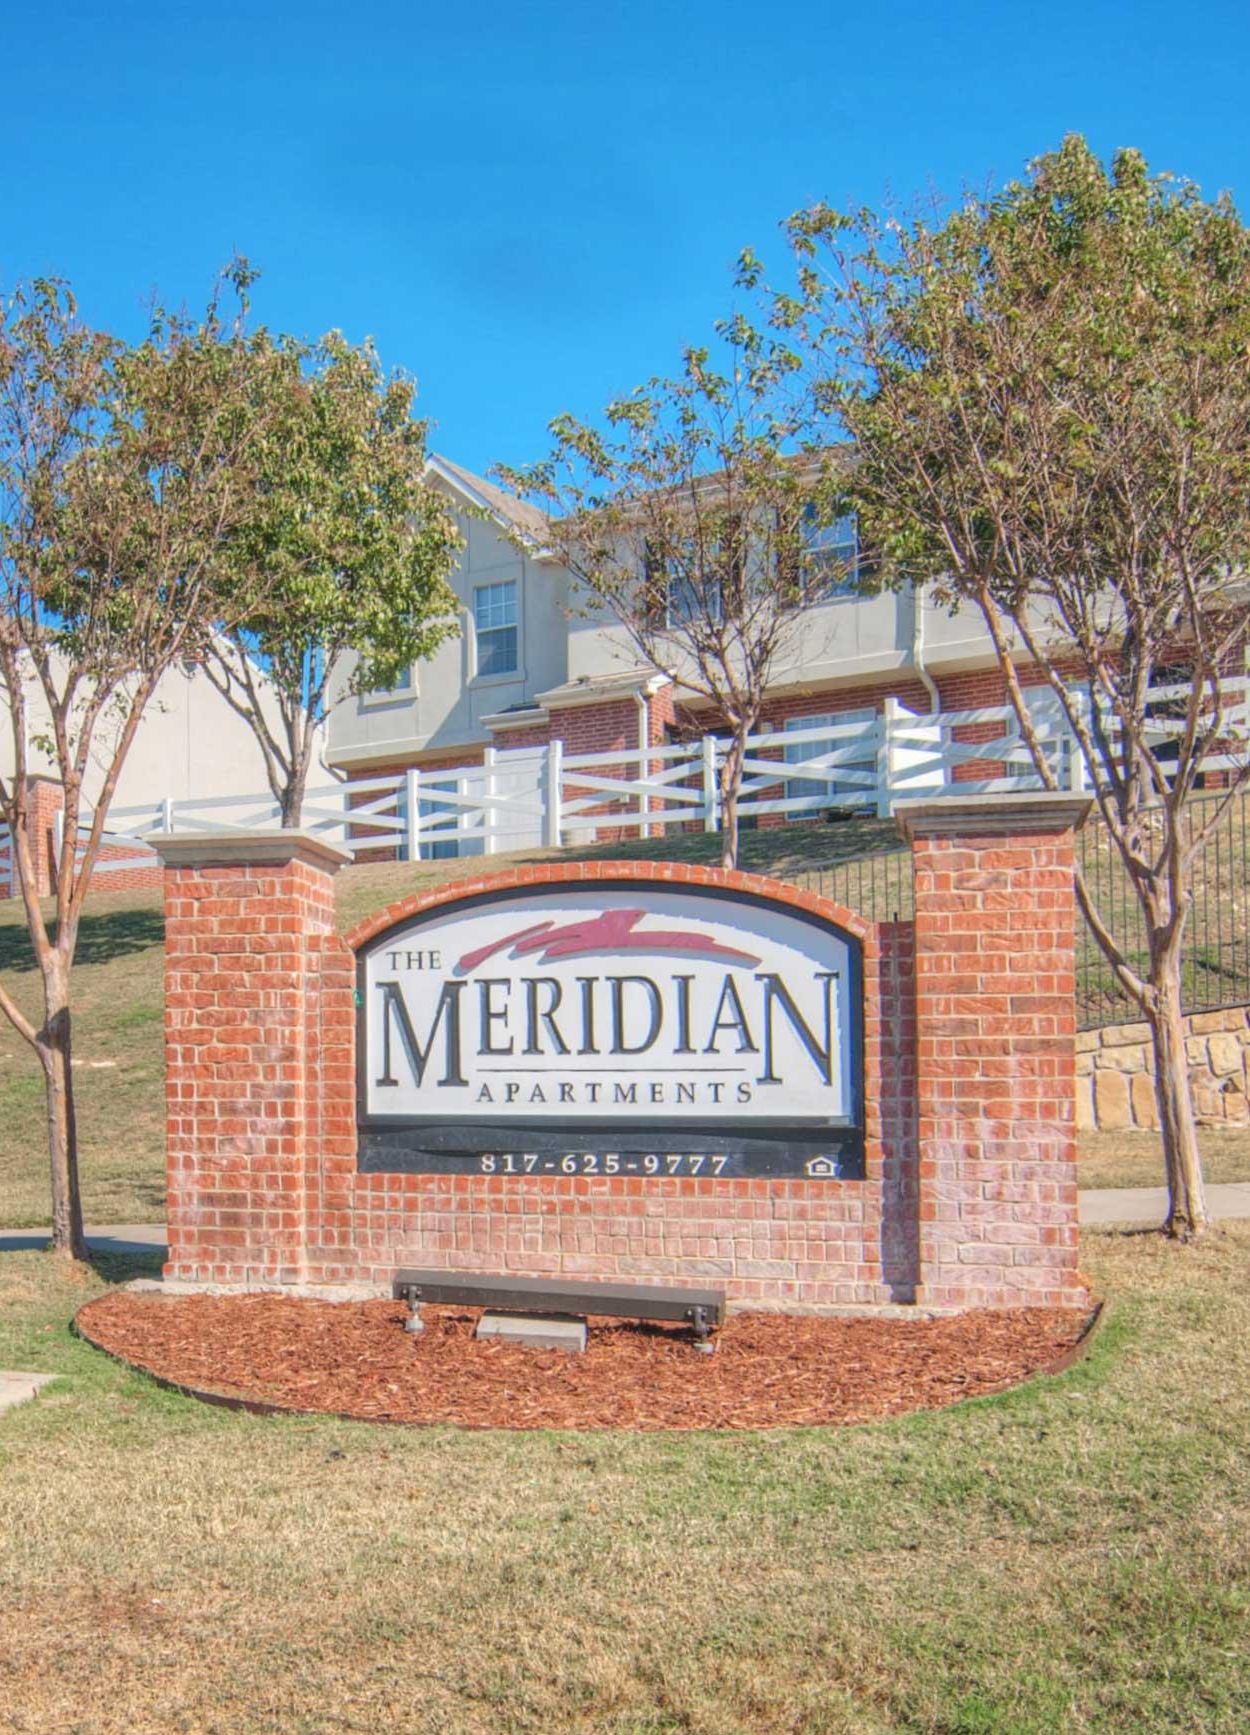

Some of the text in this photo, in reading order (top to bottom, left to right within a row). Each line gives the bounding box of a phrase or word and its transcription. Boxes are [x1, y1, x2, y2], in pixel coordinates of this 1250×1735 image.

[386, 950, 441, 970] THE
[375, 972, 839, 1087] MERIDIAN
[475, 1082, 753, 1103] APARTMENTS
[480, 1153, 729, 1175] 817-625-9777
